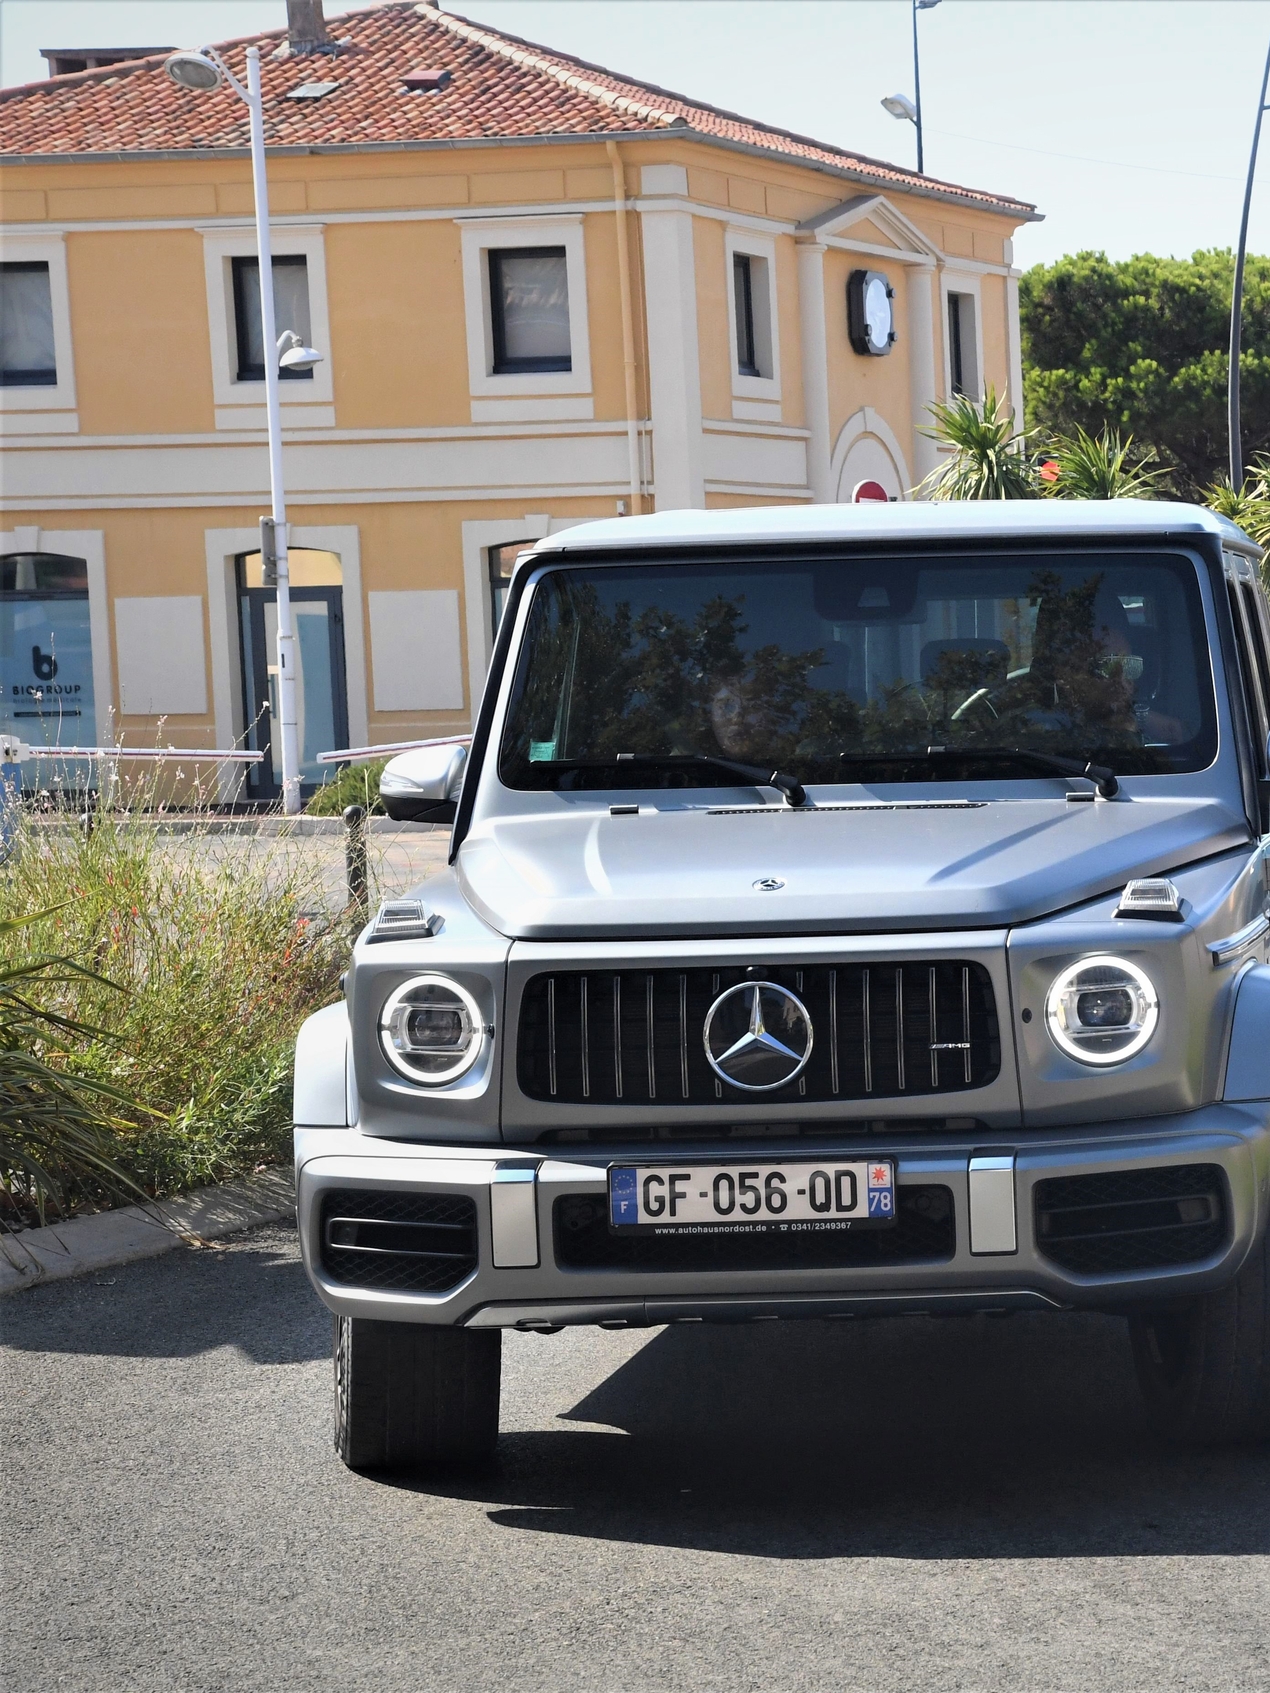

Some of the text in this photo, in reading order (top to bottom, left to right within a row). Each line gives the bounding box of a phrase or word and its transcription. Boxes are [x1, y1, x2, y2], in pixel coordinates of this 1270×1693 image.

[12, 684, 81, 696] BIOGROUP
[641, 1169, 859, 1218] GF-056-QD
[620, 1201, 629, 1214] F
[869, 1191, 892, 1213] 78
[655, 1221, 852, 1234] www.autohausnordost.de 0341/2349367
